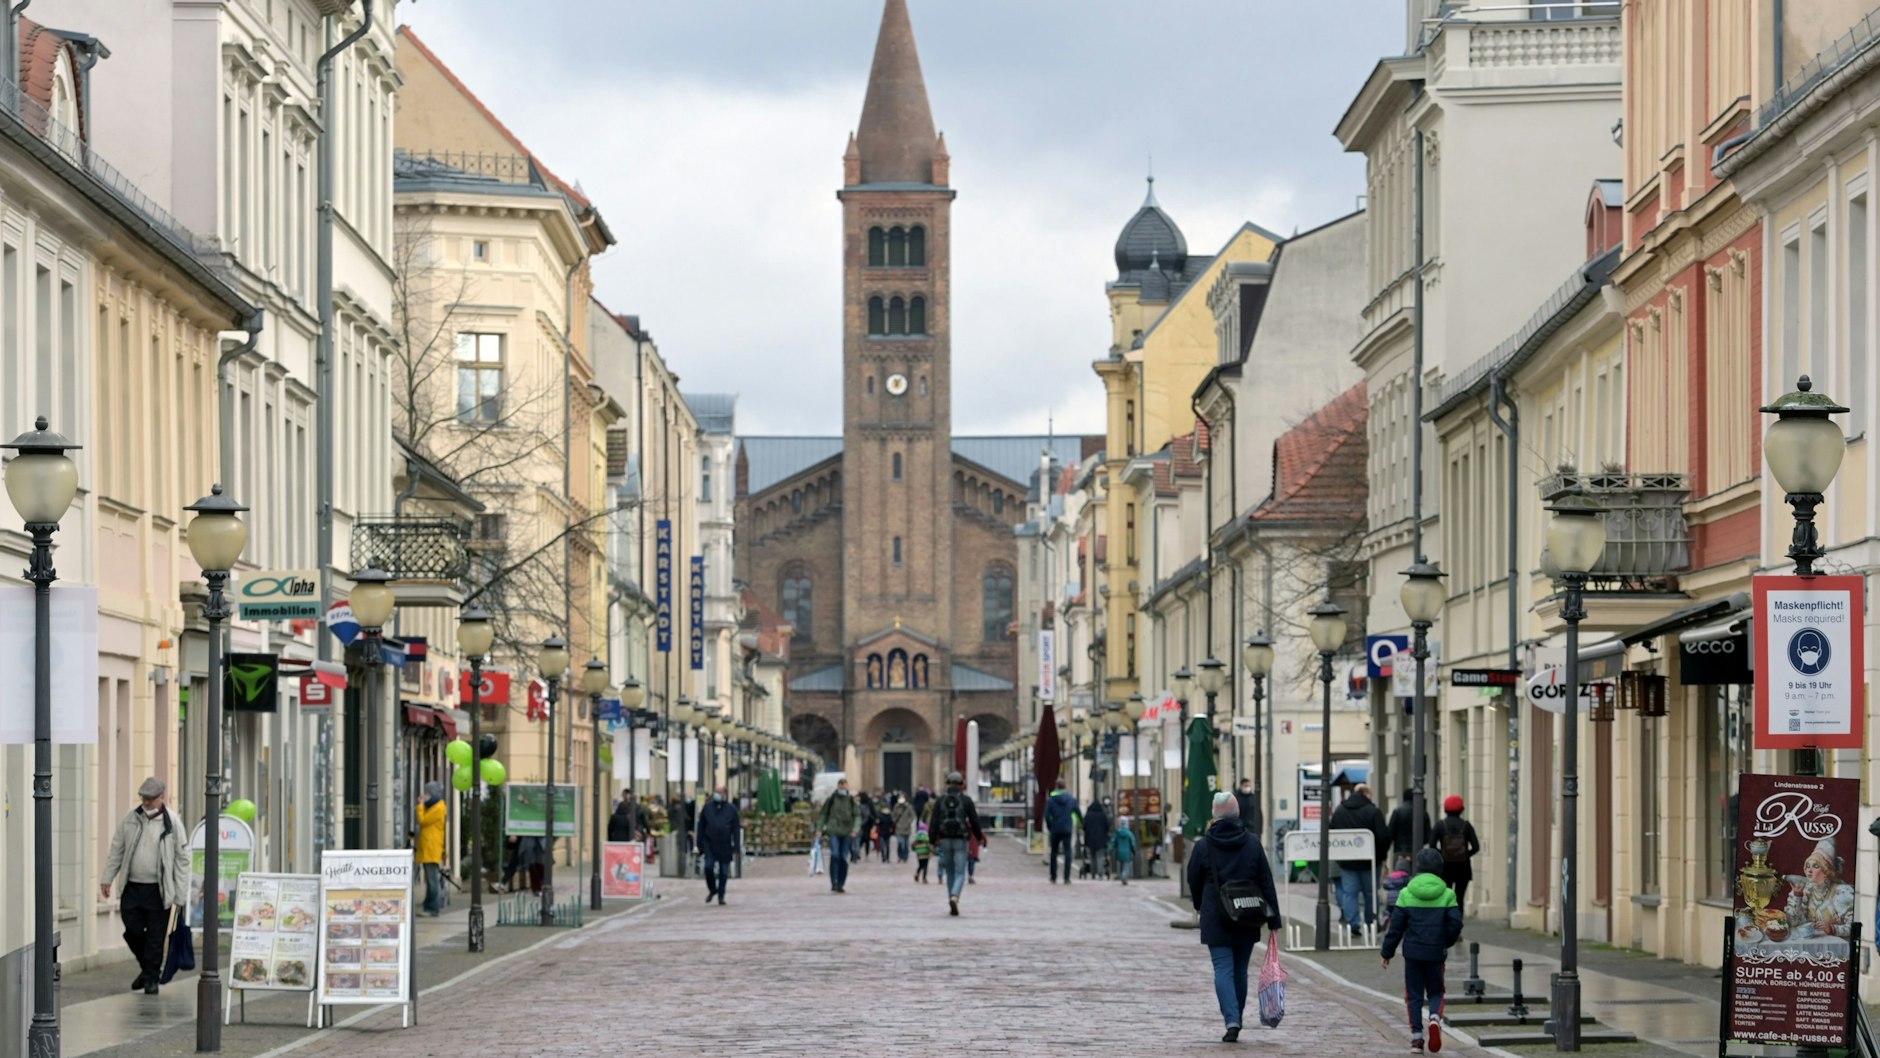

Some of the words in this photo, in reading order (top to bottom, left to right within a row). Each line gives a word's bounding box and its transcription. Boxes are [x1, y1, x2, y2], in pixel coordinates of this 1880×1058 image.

[657, 527, 669, 644] KARSTADT
[244, 606, 316, 617] Immobilien
[1774, 601, 1844, 612] Maskenpflicht!
[692, 562, 702, 663] KARSTADT
[1773, 614, 1803, 623] Masks
[1804, 614, 1845, 625] required!
[1685, 640, 1735, 654] ecco
[1795, 681, 1807, 689] bis
[1785, 692, 1790, 700] 9
[1815, 692, 1820, 700] 7
[1774, 781, 1818, 790] Lindenstrasse
[353, 866, 409, 876] ANGEBOT
[1233, 896, 1261, 909] PUMA
[1736, 966, 1783, 980] SUPPE
[1786, 969, 1802, 980] ab
[1806, 970, 1833, 982] 4,00
[1836, 972, 1846, 982] €
[1735, 978, 1768, 986] SOLJANKA,
[1769, 979, 1798, 987] BORSCH,
[1798, 980, 1846, 990] HÜHNERSUPPE
[1733, 1031, 1843, 1044] www.cafe-a-la-russe.de
